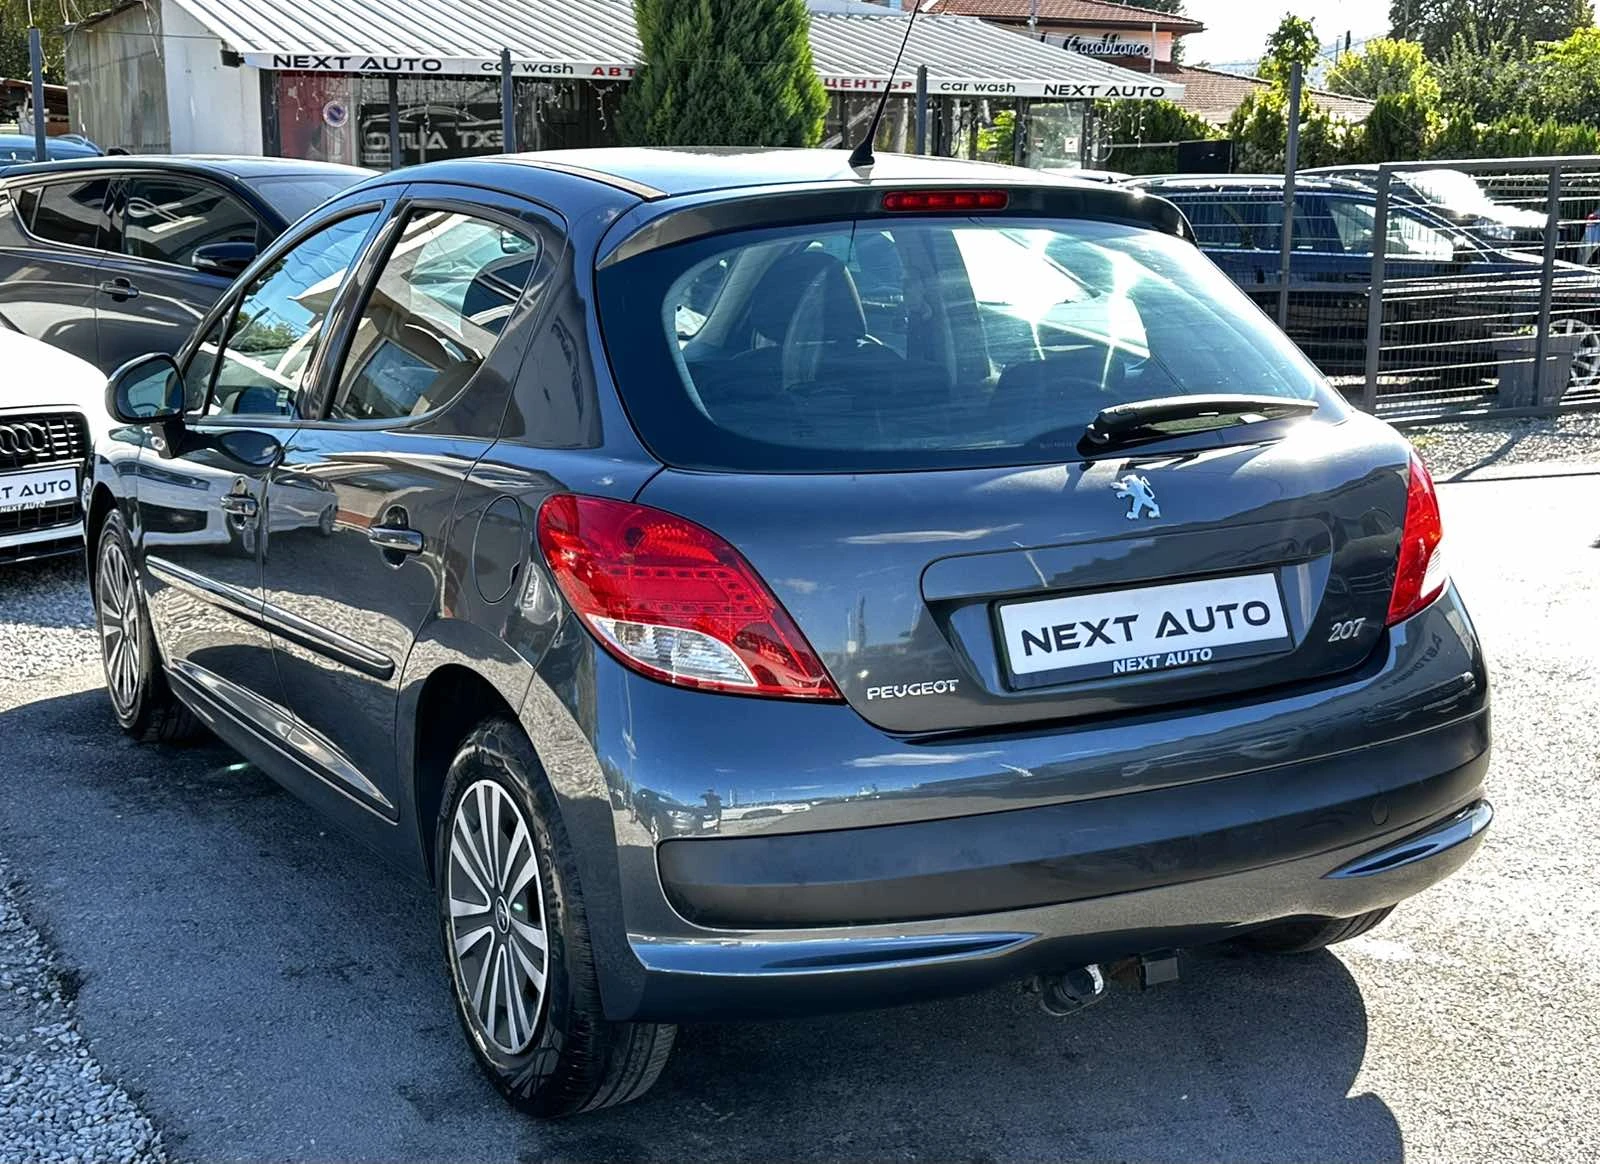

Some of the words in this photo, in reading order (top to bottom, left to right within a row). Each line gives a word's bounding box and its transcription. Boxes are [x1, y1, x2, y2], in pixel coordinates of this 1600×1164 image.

[1064, 32, 1152, 57] Casablanca
[273, 54, 350, 70] NEXT
[359, 57, 442, 72] AUTO
[522, 63, 574, 75] wash
[940, 81, 969, 93] car
[974, 81, 1016, 93] wash
[1044, 84, 1100, 97] NEXT
[1105, 85, 1165, 98] AUTO
[20, 480, 71, 497] AUTO
[1021, 614, 1139, 657] NEXT
[1155, 600, 1271, 639] AUTO
[1327, 617, 1367, 643] 207
[1112, 655, 1160, 674] NEXT
[1164, 647, 1213, 666] AUTO
[866, 679, 959, 700] PEUGEOT
